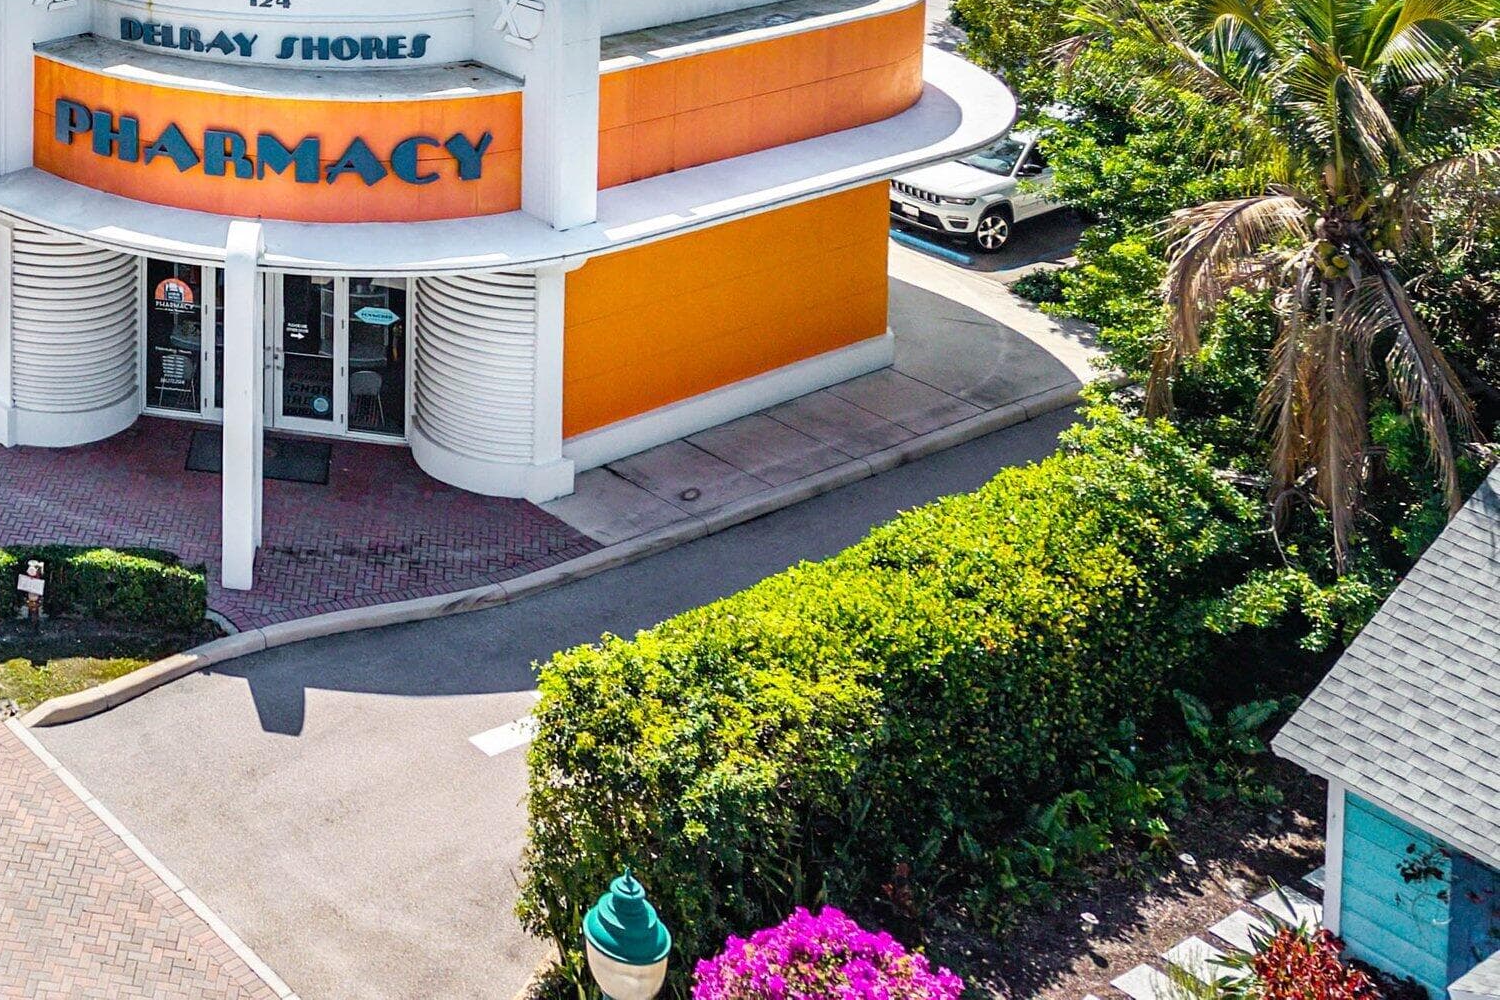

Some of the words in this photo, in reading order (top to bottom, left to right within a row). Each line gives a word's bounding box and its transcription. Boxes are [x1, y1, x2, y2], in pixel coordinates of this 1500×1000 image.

[120, 16, 258, 58] DELRAY
[275, 33, 432, 61] SHORES
[55, 97, 494, 188] PHARMACY
[155, 300, 195, 310] PHARMACY
